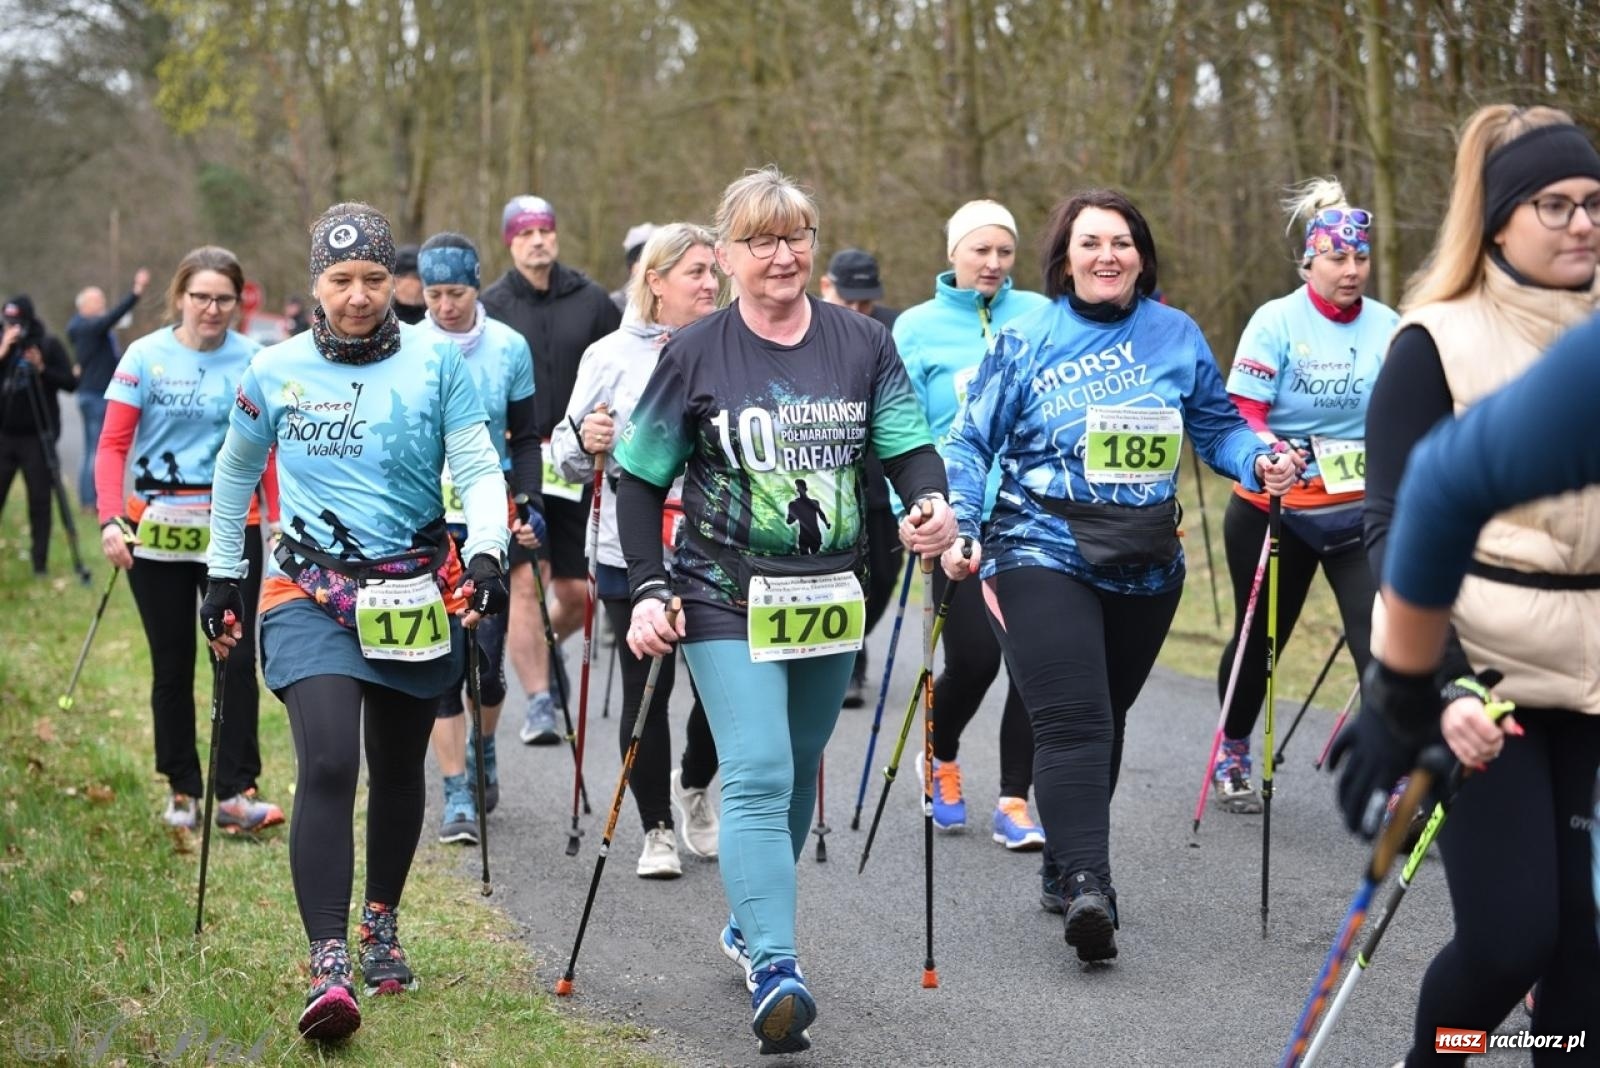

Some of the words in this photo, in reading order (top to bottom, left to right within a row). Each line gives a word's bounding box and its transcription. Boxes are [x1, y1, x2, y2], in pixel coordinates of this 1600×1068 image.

[1032, 341, 1136, 396] MORSY
[1041, 364, 1152, 421] RACIBÓRZ
[1313, 396, 1361, 410] Walking
[778, 399, 867, 425] KUŹNIAŃSKI
[286, 413, 367, 441] Nordic
[711, 406, 777, 471] 10
[781, 427, 846, 442] PÓŁMARATON
[307, 442, 363, 459] Walking
[1103, 435, 1167, 469] 185
[1334, 452, 1366, 481] 16
[149, 524, 203, 551] 153
[375, 606, 442, 646] 171
[768, 605, 849, 644] 170
